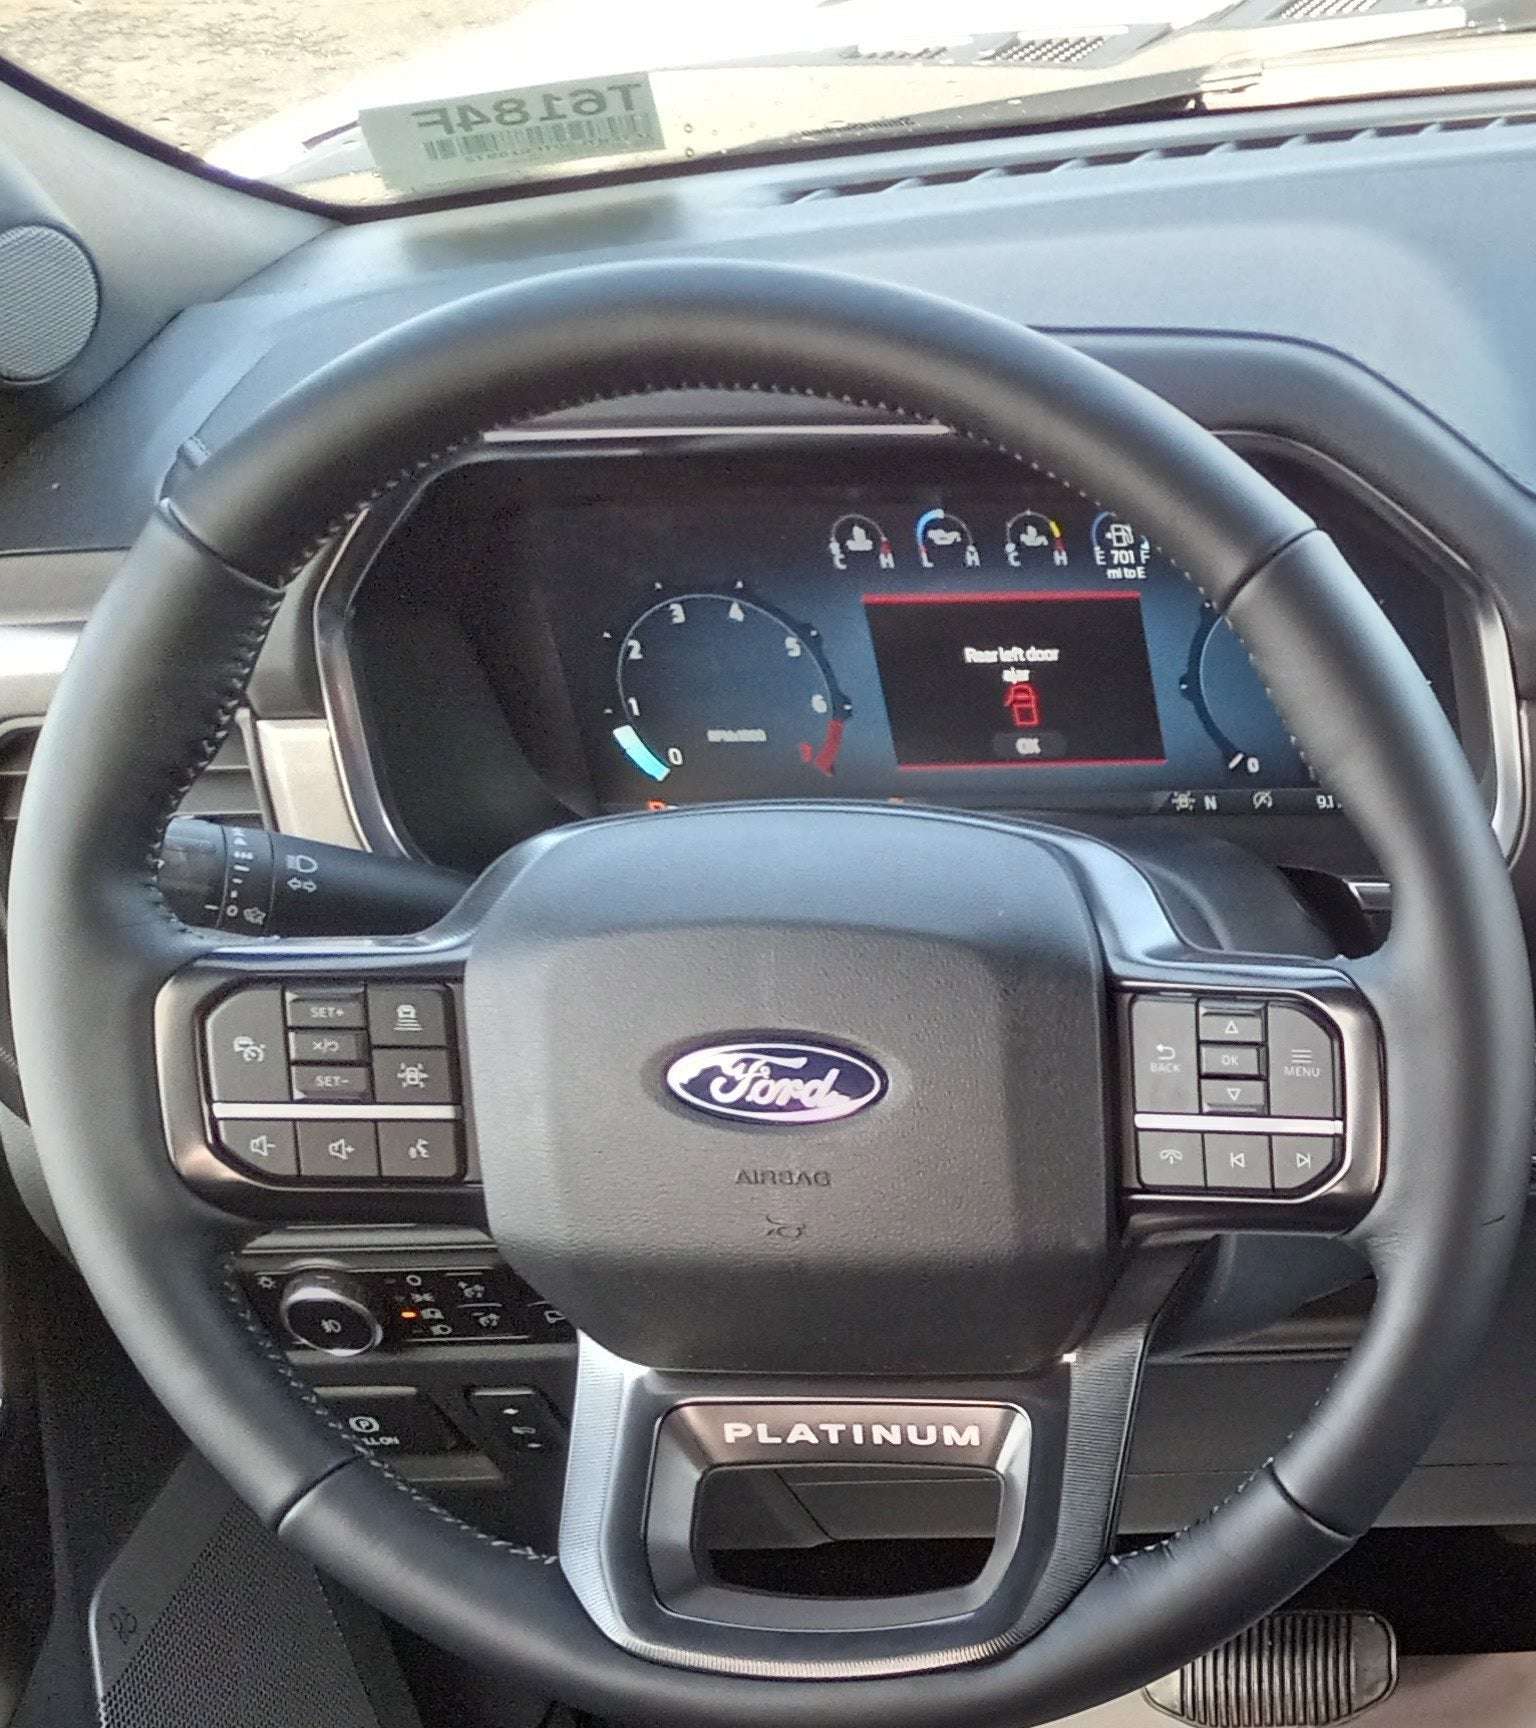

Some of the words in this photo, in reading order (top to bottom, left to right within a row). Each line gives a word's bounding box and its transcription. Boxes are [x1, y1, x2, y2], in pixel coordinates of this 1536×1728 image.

[1054, 551, 1068, 567] H
[1111, 550, 1135, 566] 701
[669, 603, 686, 624] 3
[729, 601, 744, 622] 4
[627, 639, 643, 660] 2
[785, 636, 801, 657] 5
[964, 646, 998, 663] Rear
[998, 646, 1026, 662] left
[1025, 645, 1060, 662] door
[628, 697, 640, 717] 1
[811, 694, 827, 714] 6
[667, 747, 683, 766] 0
[1203, 795, 1217, 811] N
[310, 1006, 345, 1018] SET+
[1150, 1062, 1181, 1074] BACK
[1221, 1054, 1239, 1067] OK
[1284, 1065, 1320, 1078] MENU
[734, 1167, 832, 1188] AIRBAG
[722, 1420, 983, 1448] PLATINUM
